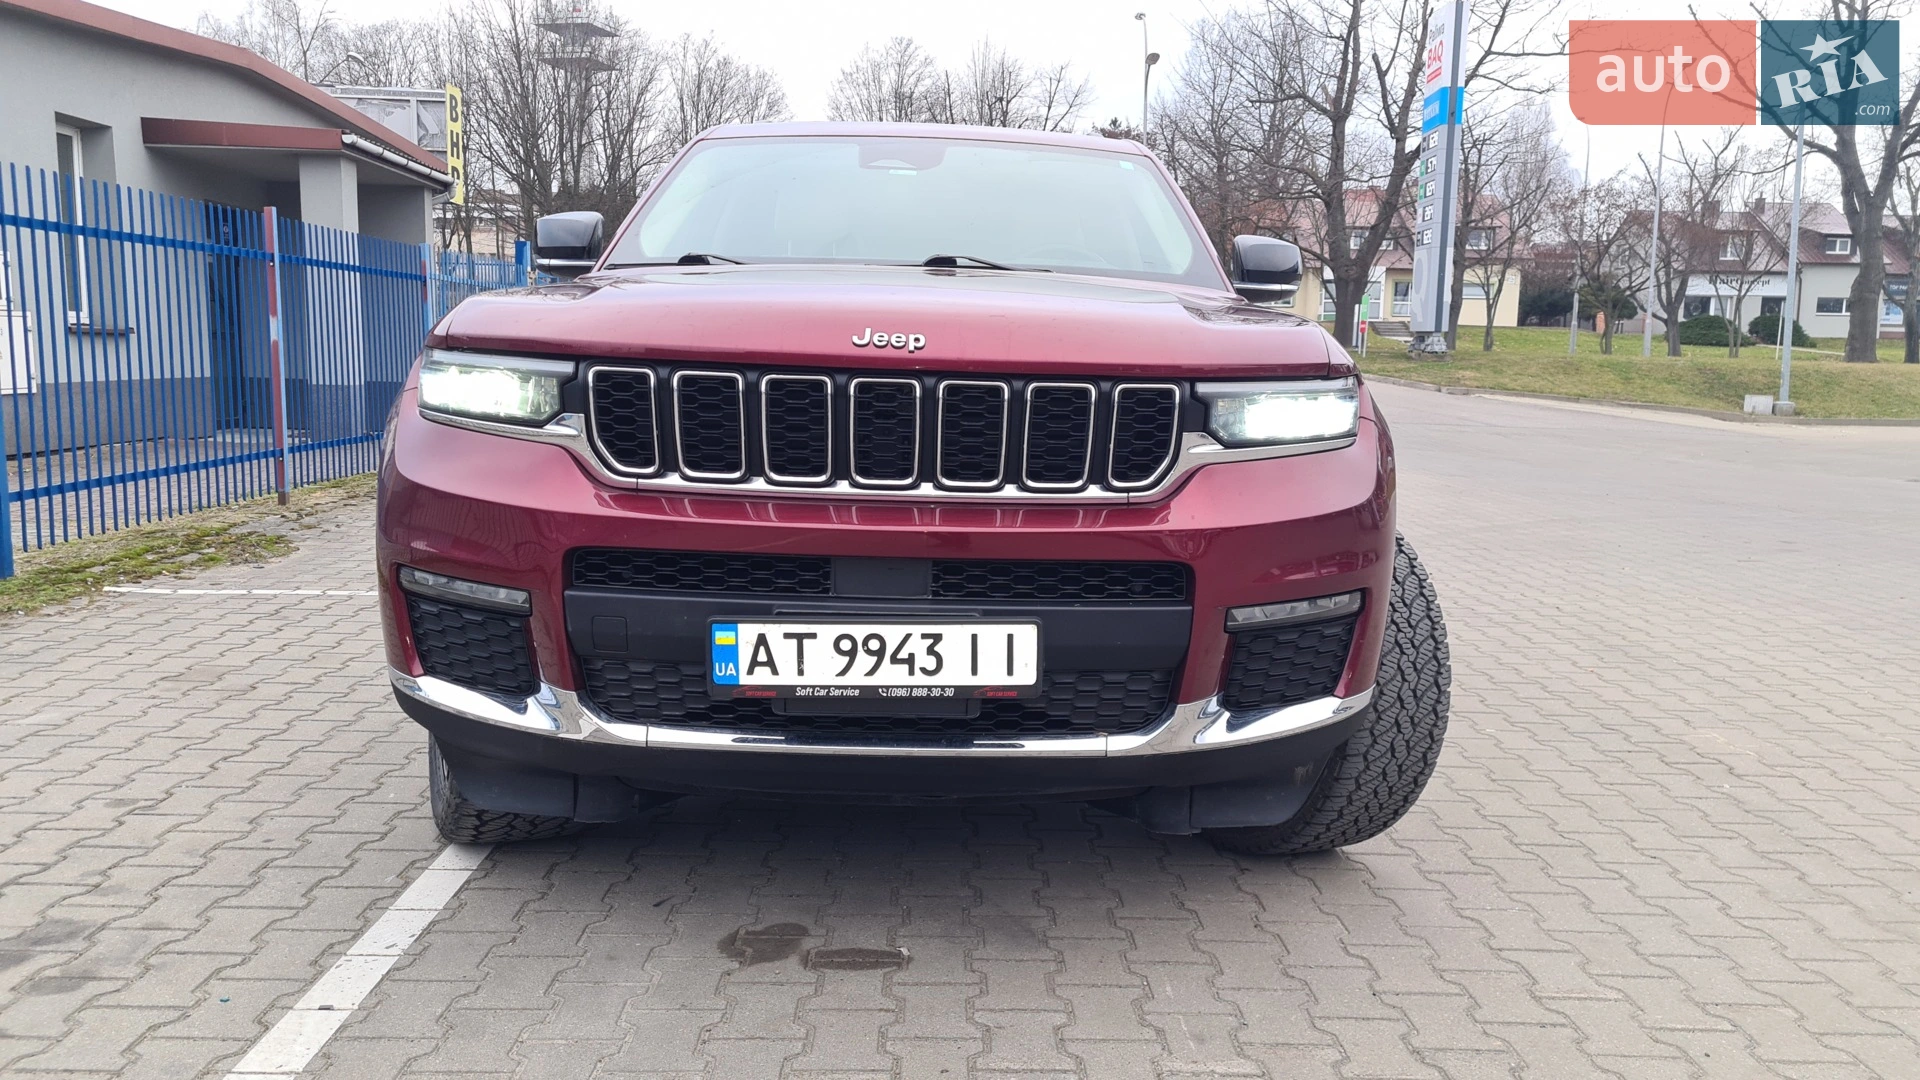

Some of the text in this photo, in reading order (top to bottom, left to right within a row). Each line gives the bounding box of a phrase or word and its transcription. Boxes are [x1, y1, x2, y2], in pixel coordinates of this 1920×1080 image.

[1427, 40, 1444, 69] BAQ
[852, 327, 926, 353] Jeep
[746, 632, 818, 677] AT
[833, 633, 944, 677] 9943
[715, 662, 737, 677] UA
[795, 686, 860, 697] Soft Car Service
[887, 687, 955, 697] (096) 888-30-30
